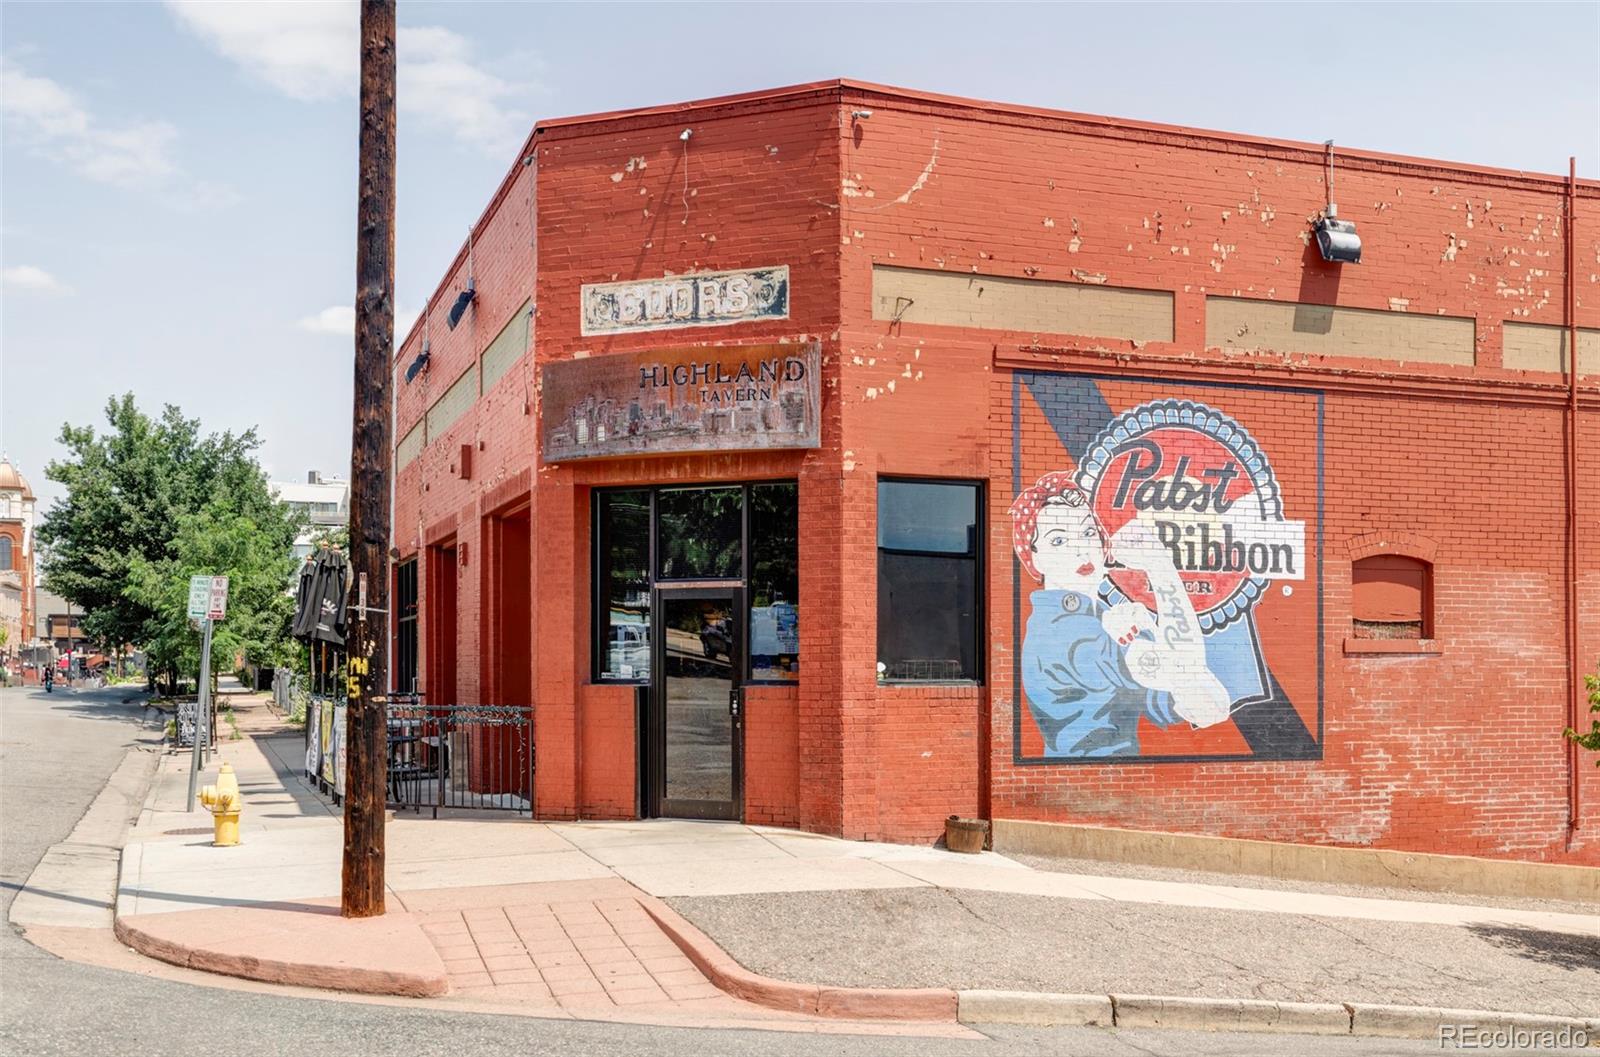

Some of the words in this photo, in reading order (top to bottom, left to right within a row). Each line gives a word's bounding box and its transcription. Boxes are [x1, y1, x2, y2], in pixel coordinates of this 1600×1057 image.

[639, 360, 805, 388] HIGHLAND
[700, 388, 771, 403] TAVERN
[1110, 439, 1239, 514] Pabst
[1154, 520, 1296, 575] Ribbon
[1160, 585, 1194, 650] Pabst
